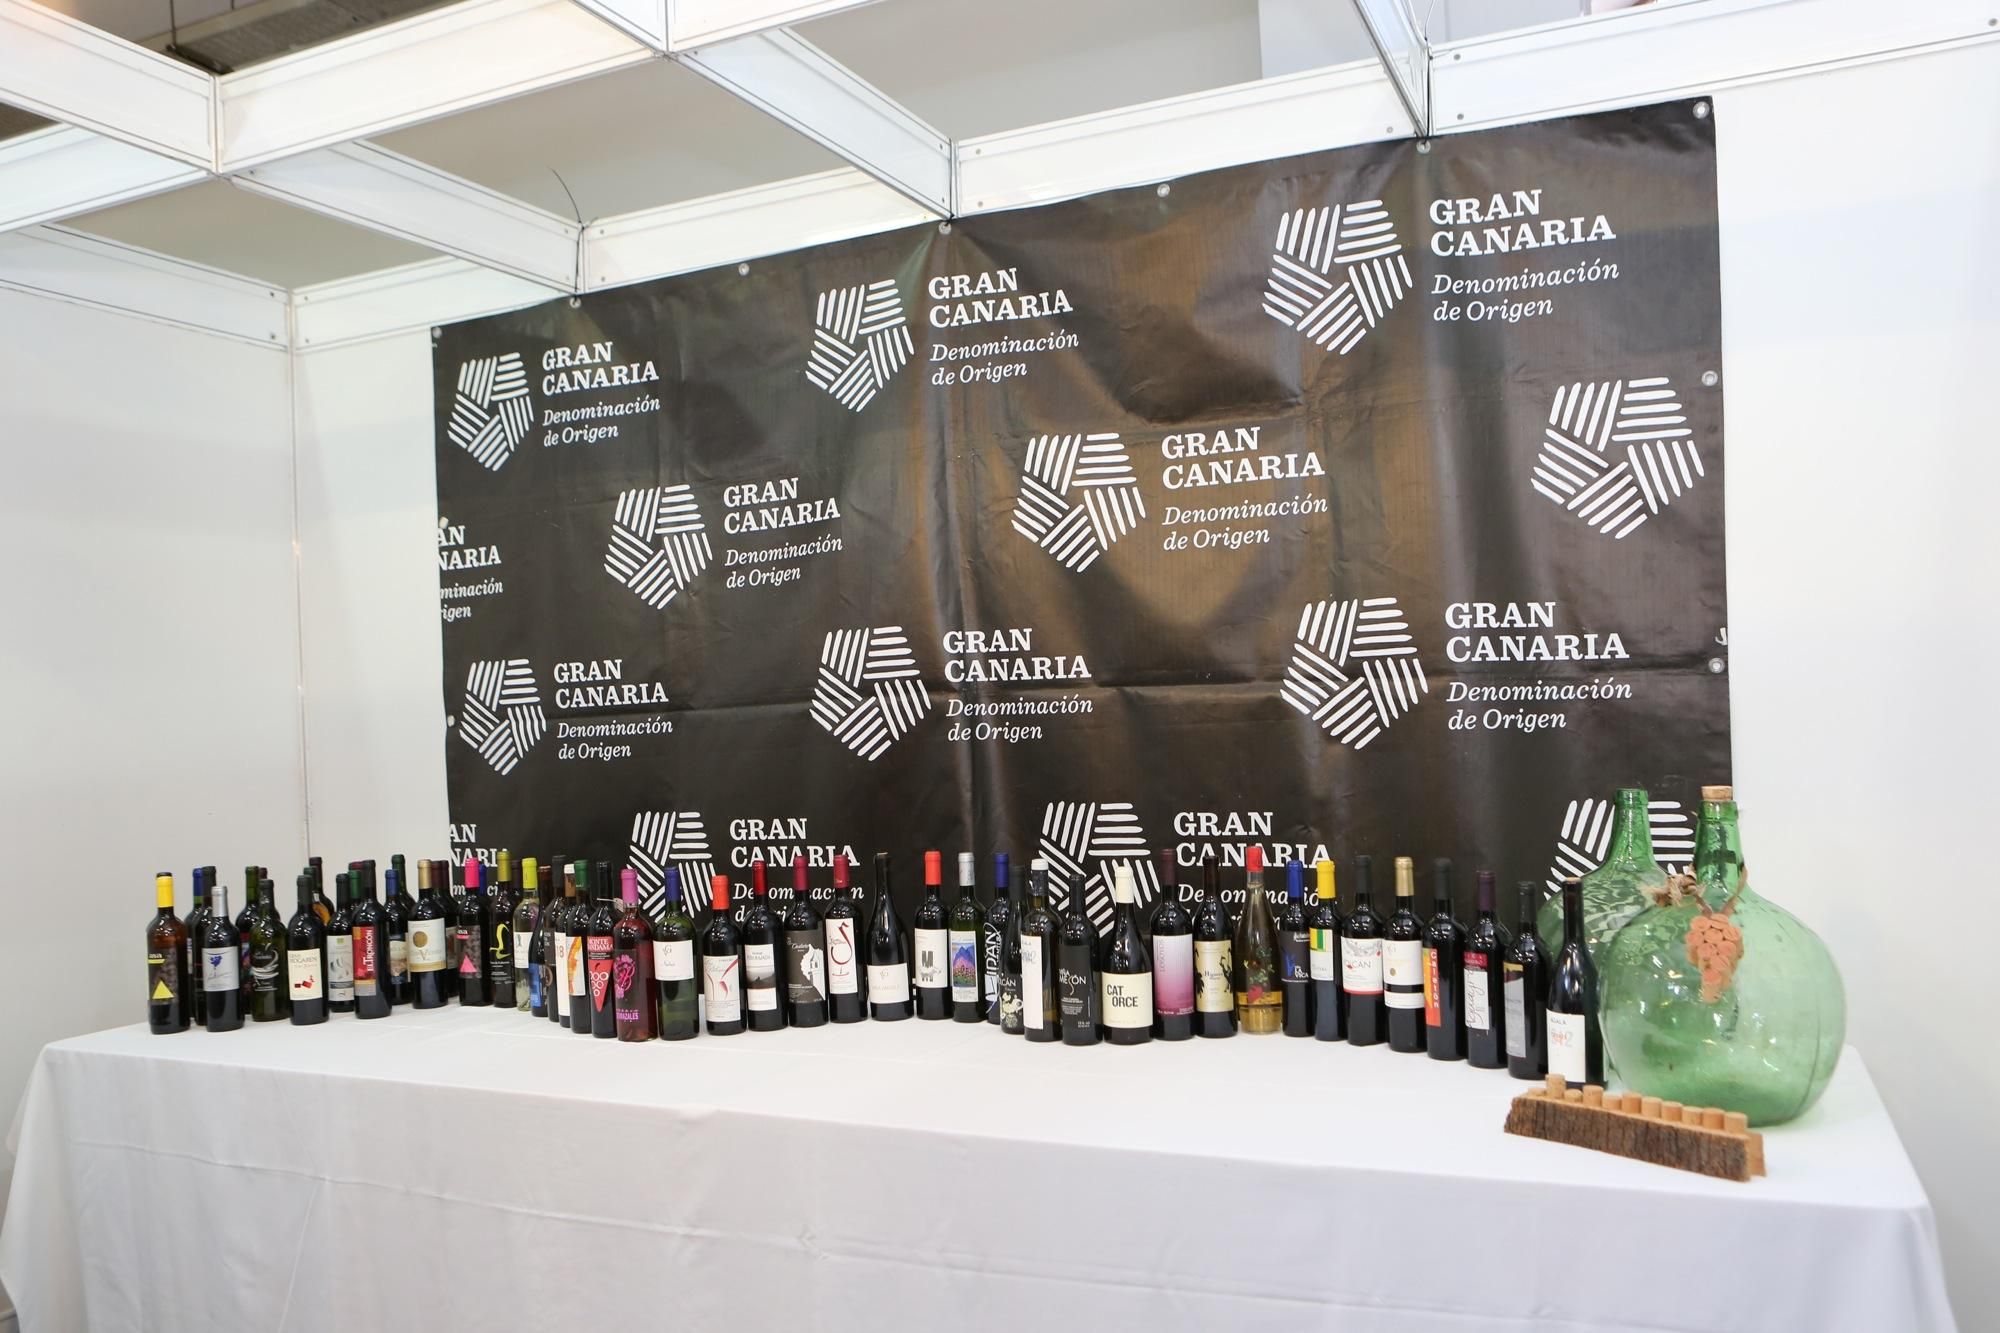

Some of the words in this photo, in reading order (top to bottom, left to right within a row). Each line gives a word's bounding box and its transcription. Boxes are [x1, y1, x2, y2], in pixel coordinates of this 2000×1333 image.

[1430, 189, 1542, 225] GRAN
[1431, 215, 1616, 256] CANARIA
[929, 268, 1017, 299] GRAN
[1431, 258, 1619, 294] Denominación
[930, 290, 1073, 328] CANARIA
[1434, 301, 1460, 323] de
[1467, 299, 1553, 323] Origen
[543, 342, 613, 371] GRAN
[930, 329, 1079, 361] Denominación
[543, 361, 659, 396] CANARIA
[932, 367, 955, 386] de
[960, 362, 1028, 385] Origen
[543, 395, 660, 426] Denominación
[544, 429, 559, 447] de
[562, 424, 619, 444] Origen
[1162, 427, 1260, 459] GRAN
[1163, 452, 1325, 489] CANARIA
[724, 478, 798, 507] GRAN
[724, 498, 840, 534] CANARIA
[1162, 493, 1327, 525] Denominación
[725, 534, 842, 566] Denominación
[1163, 530, 1189, 550] de
[1193, 527, 1270, 550] Origen
[727, 571, 746, 588] de
[749, 567, 801, 586] Origen
[1445, 602, 1556, 629] GRAN
[943, 628, 1032, 653] GRAN
[1446, 633, 1629, 662] CANARIA
[554, 659, 622, 683] GRAN
[945, 656, 1091, 682] CANARIA
[556, 682, 668, 708] CANARIA
[1446, 677, 1632, 701] Denominación
[946, 694, 1093, 716] Denominación
[557, 716, 672, 738] Denominación
[948, 724, 971, 742] de
[976, 722, 1042, 743] Origen
[1448, 709, 1476, 730] de
[1483, 708, 1566, 732] Origen
[559, 744, 575, 760] de
[578, 742, 632, 761] Origen
[730, 818, 807, 841] GRAN
[1174, 812, 1273, 836] GRAN
[450, 848, 507, 868] NARI
[1107, 984, 1124, 996] CAT
[1112, 996, 1138, 1007] ORCE
